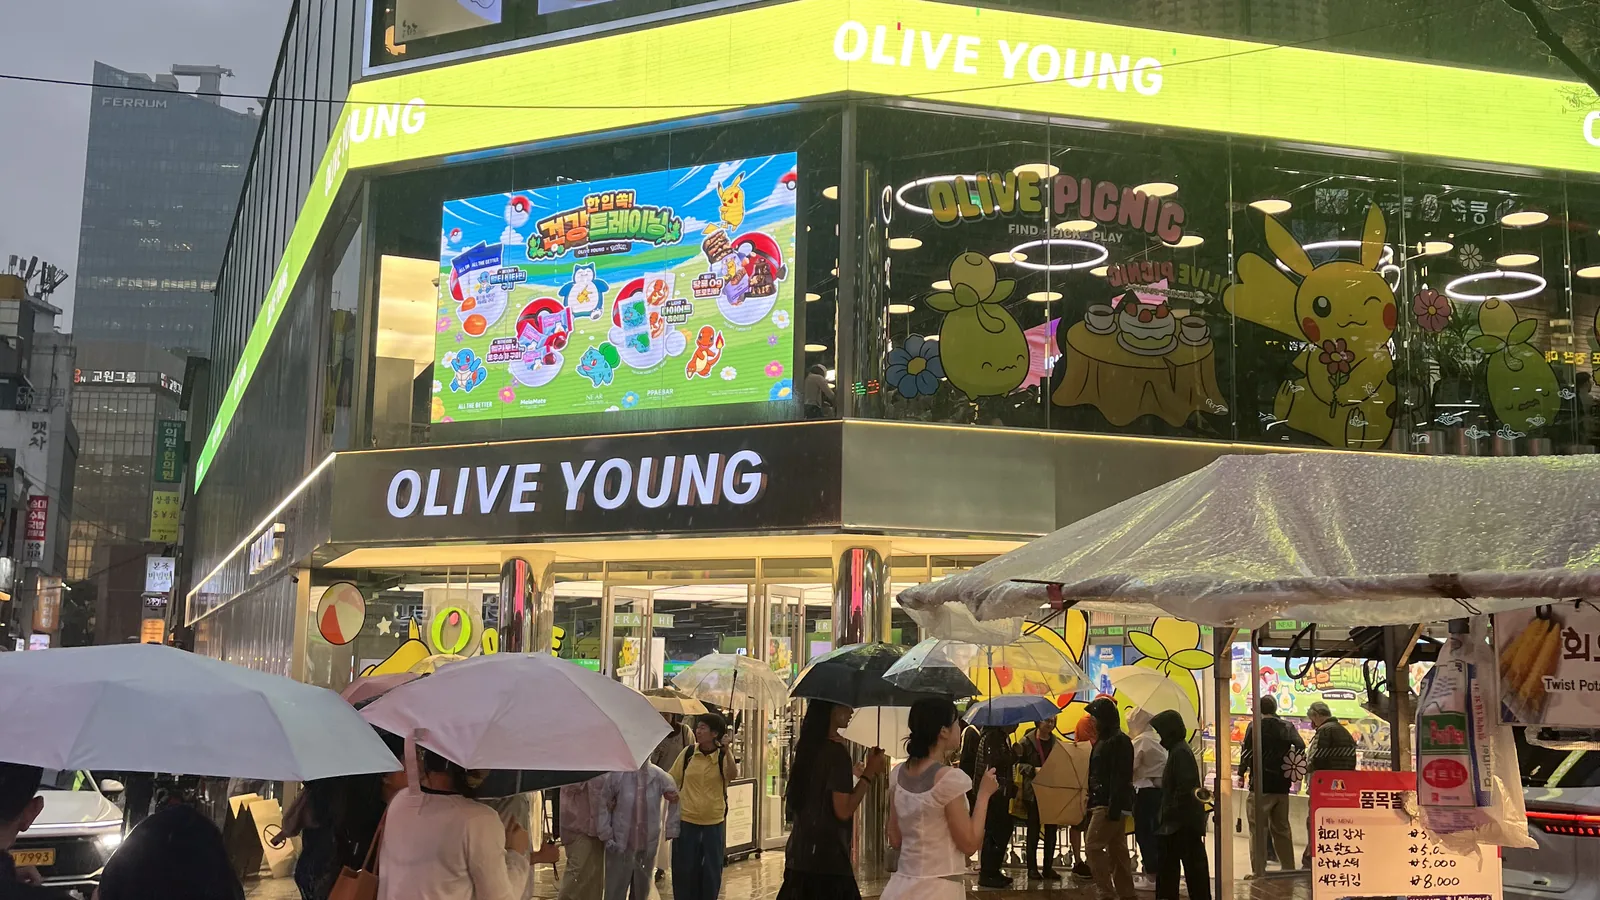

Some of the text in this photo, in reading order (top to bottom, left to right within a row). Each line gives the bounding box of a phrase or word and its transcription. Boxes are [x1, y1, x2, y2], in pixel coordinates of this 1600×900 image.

[833, 20, 1164, 97] OLIVE YOUNG
[102, 97, 168, 109] FERRUM
[926, 171, 1186, 244] OLIVE PICNIC
[1008, 223, 1124, 244] FIND PICK PLAY
[92, 370, 137, 383] 교원그룹
[387, 450, 766, 518] OLIVE YOUNG
[1562, 626, 1600, 662] 회
[1545, 678, 1575, 691] Twist
[20, 852, 49, 864] 7993
